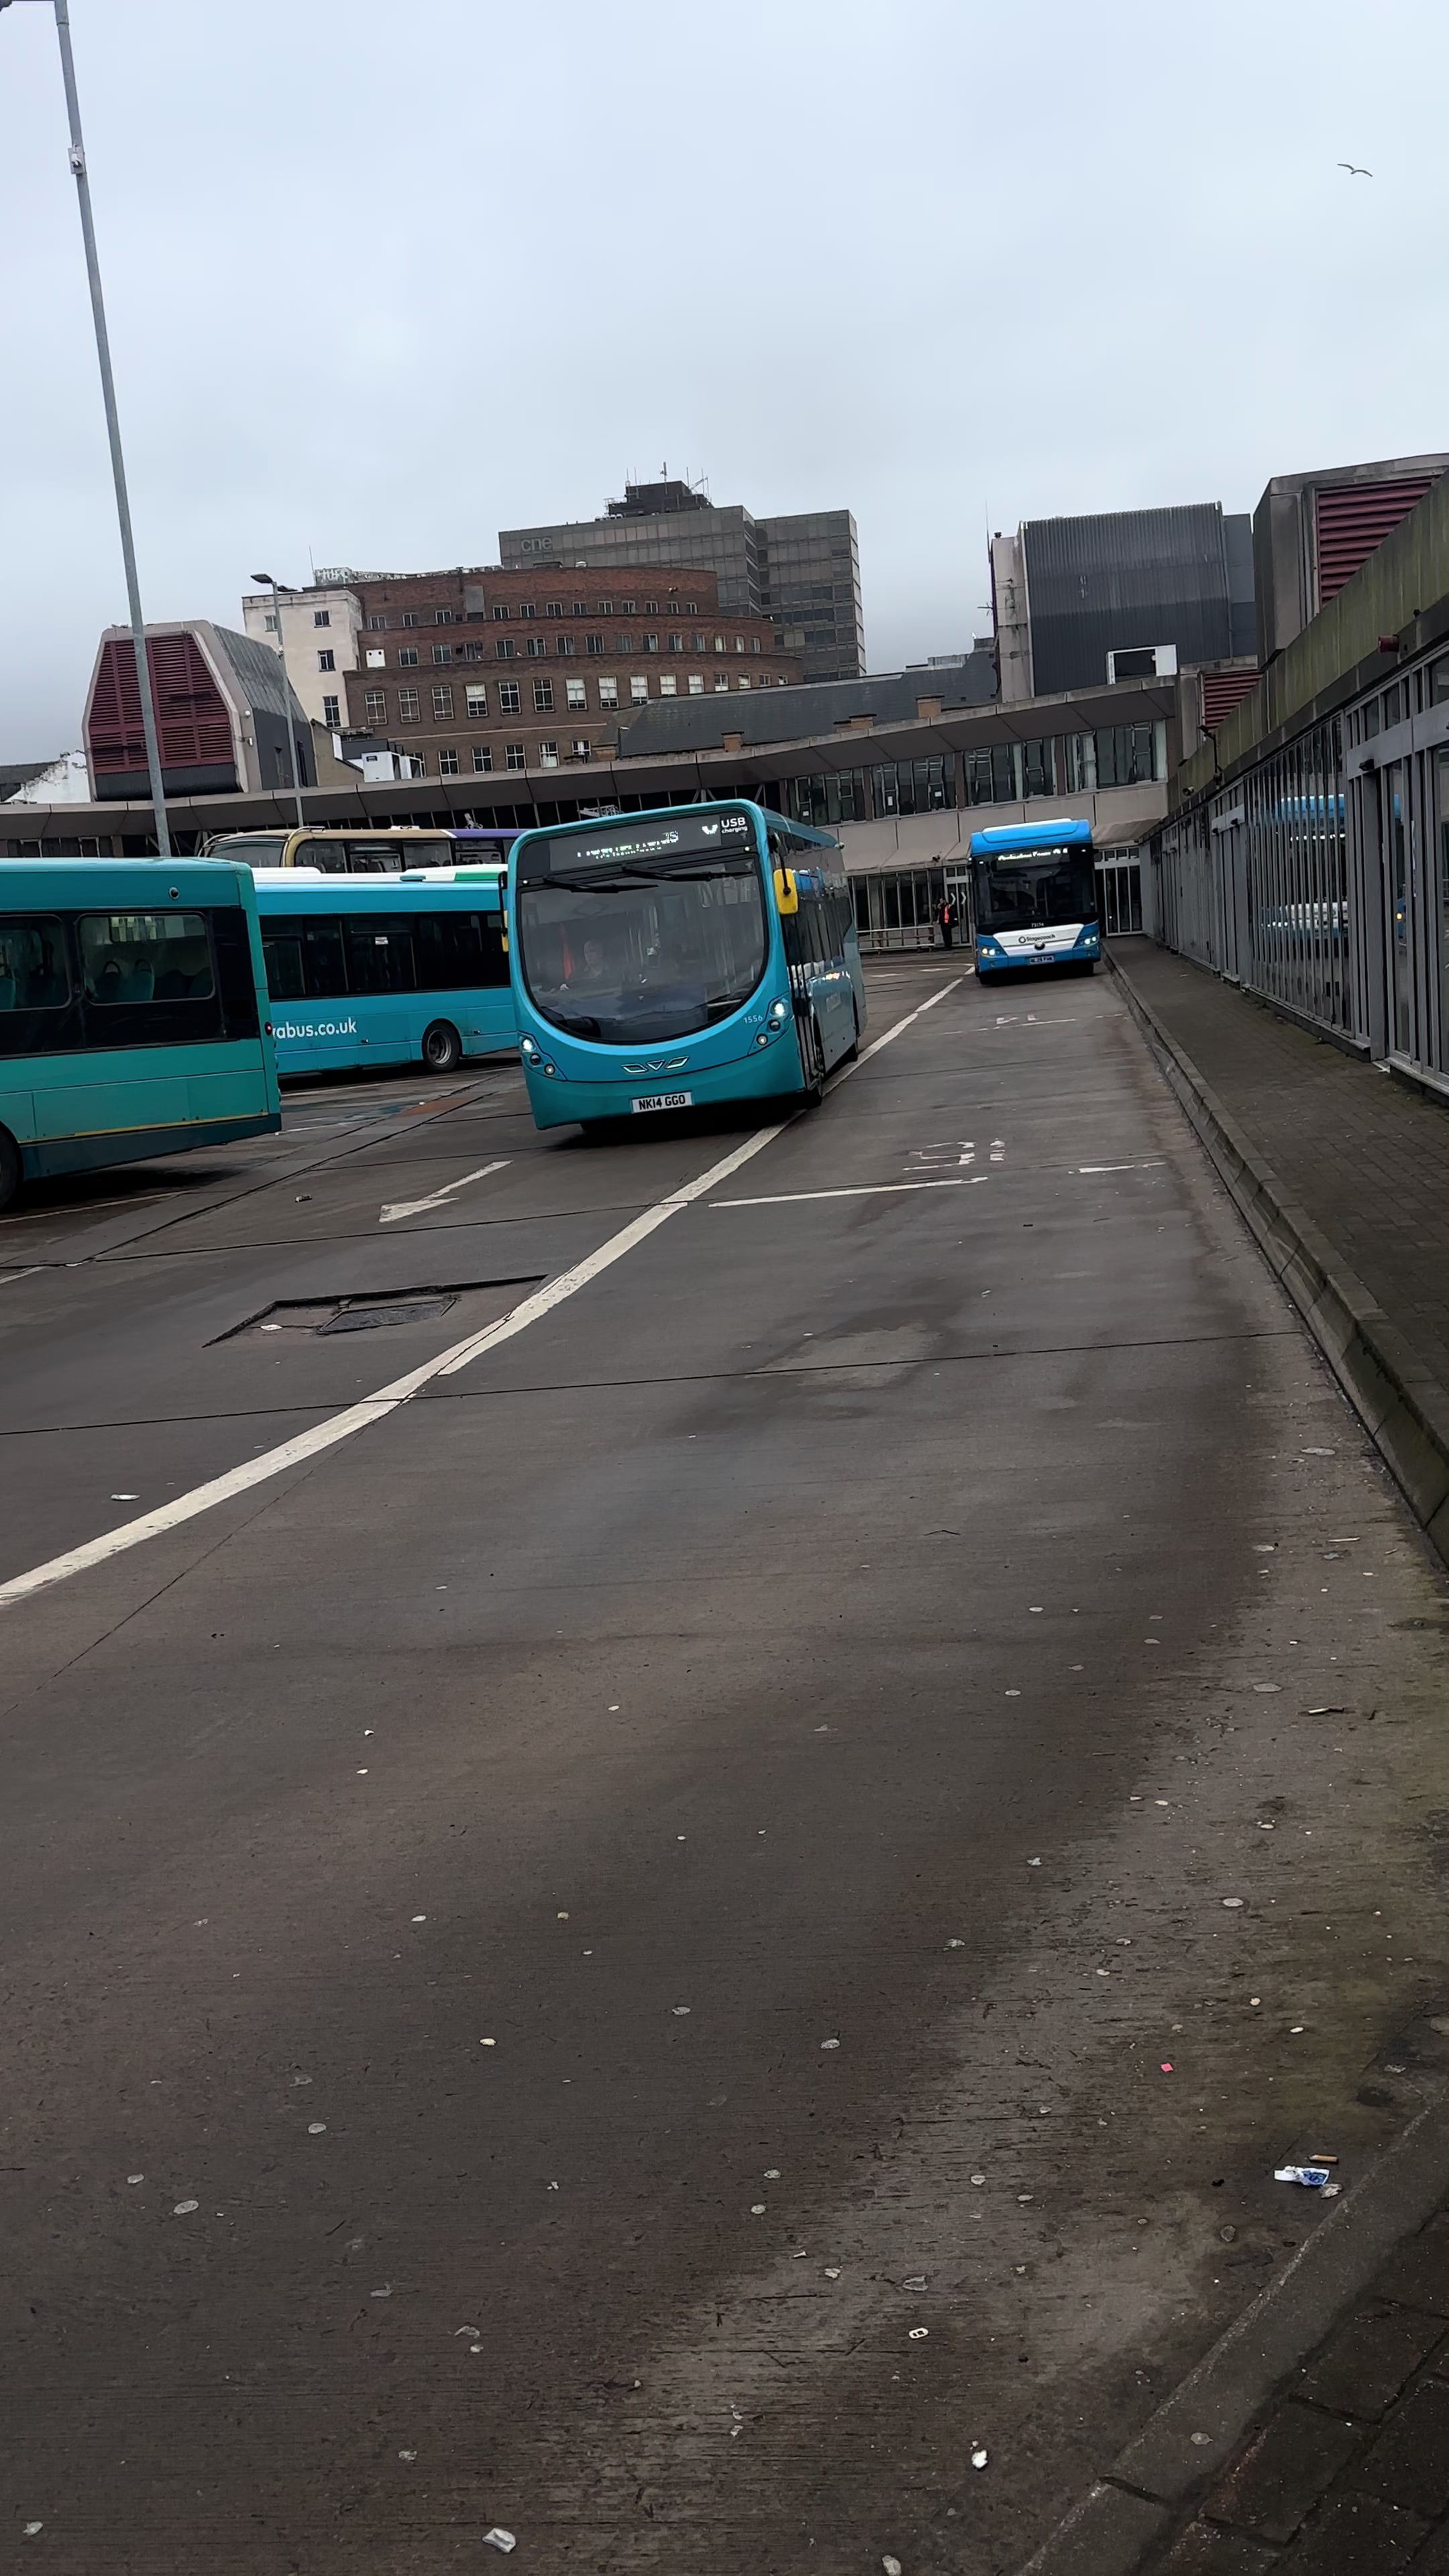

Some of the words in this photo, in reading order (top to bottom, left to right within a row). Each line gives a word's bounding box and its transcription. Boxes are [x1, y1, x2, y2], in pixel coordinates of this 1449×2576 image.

[521, 537, 551, 551] cne
[721, 817, 746, 828] USB
[721, 825, 748, 835] charging
[744, 1014, 763, 1024] 1556
[639, 1097, 662, 1110] NK14
[665, 1094, 686, 1106] GGO
